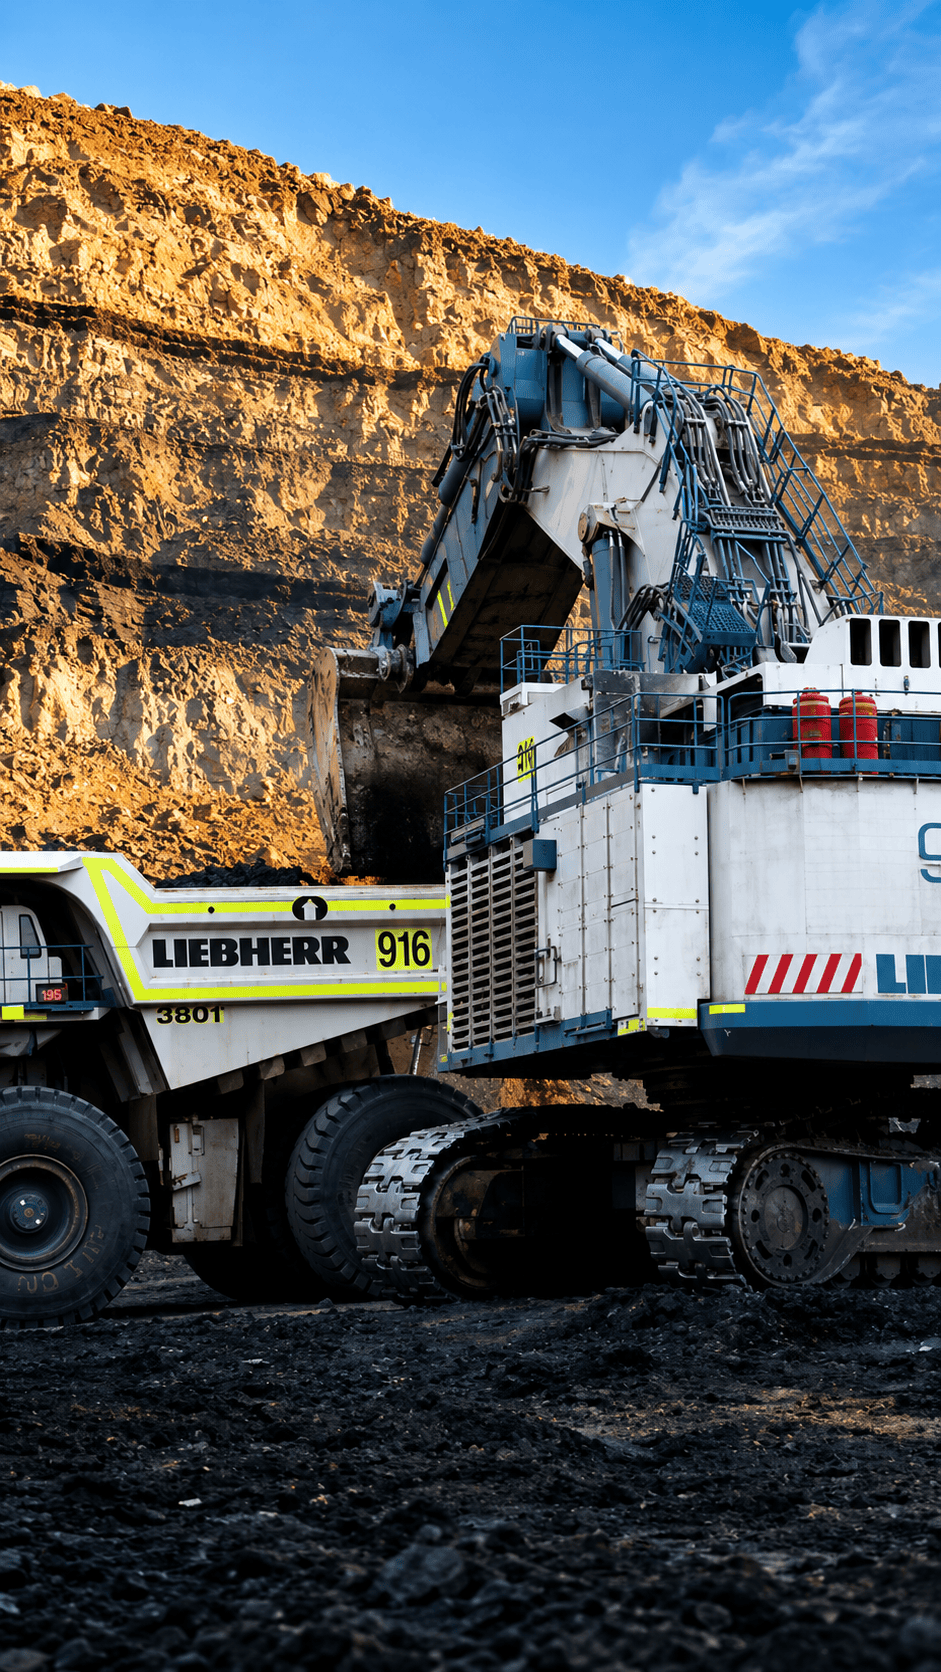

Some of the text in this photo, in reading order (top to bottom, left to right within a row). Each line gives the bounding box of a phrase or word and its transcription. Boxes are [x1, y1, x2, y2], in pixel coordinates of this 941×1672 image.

[152, 936, 351, 968] LIEBHERR
[377, 930, 431, 967] 916
[156, 1005, 220, 1024] 3801
